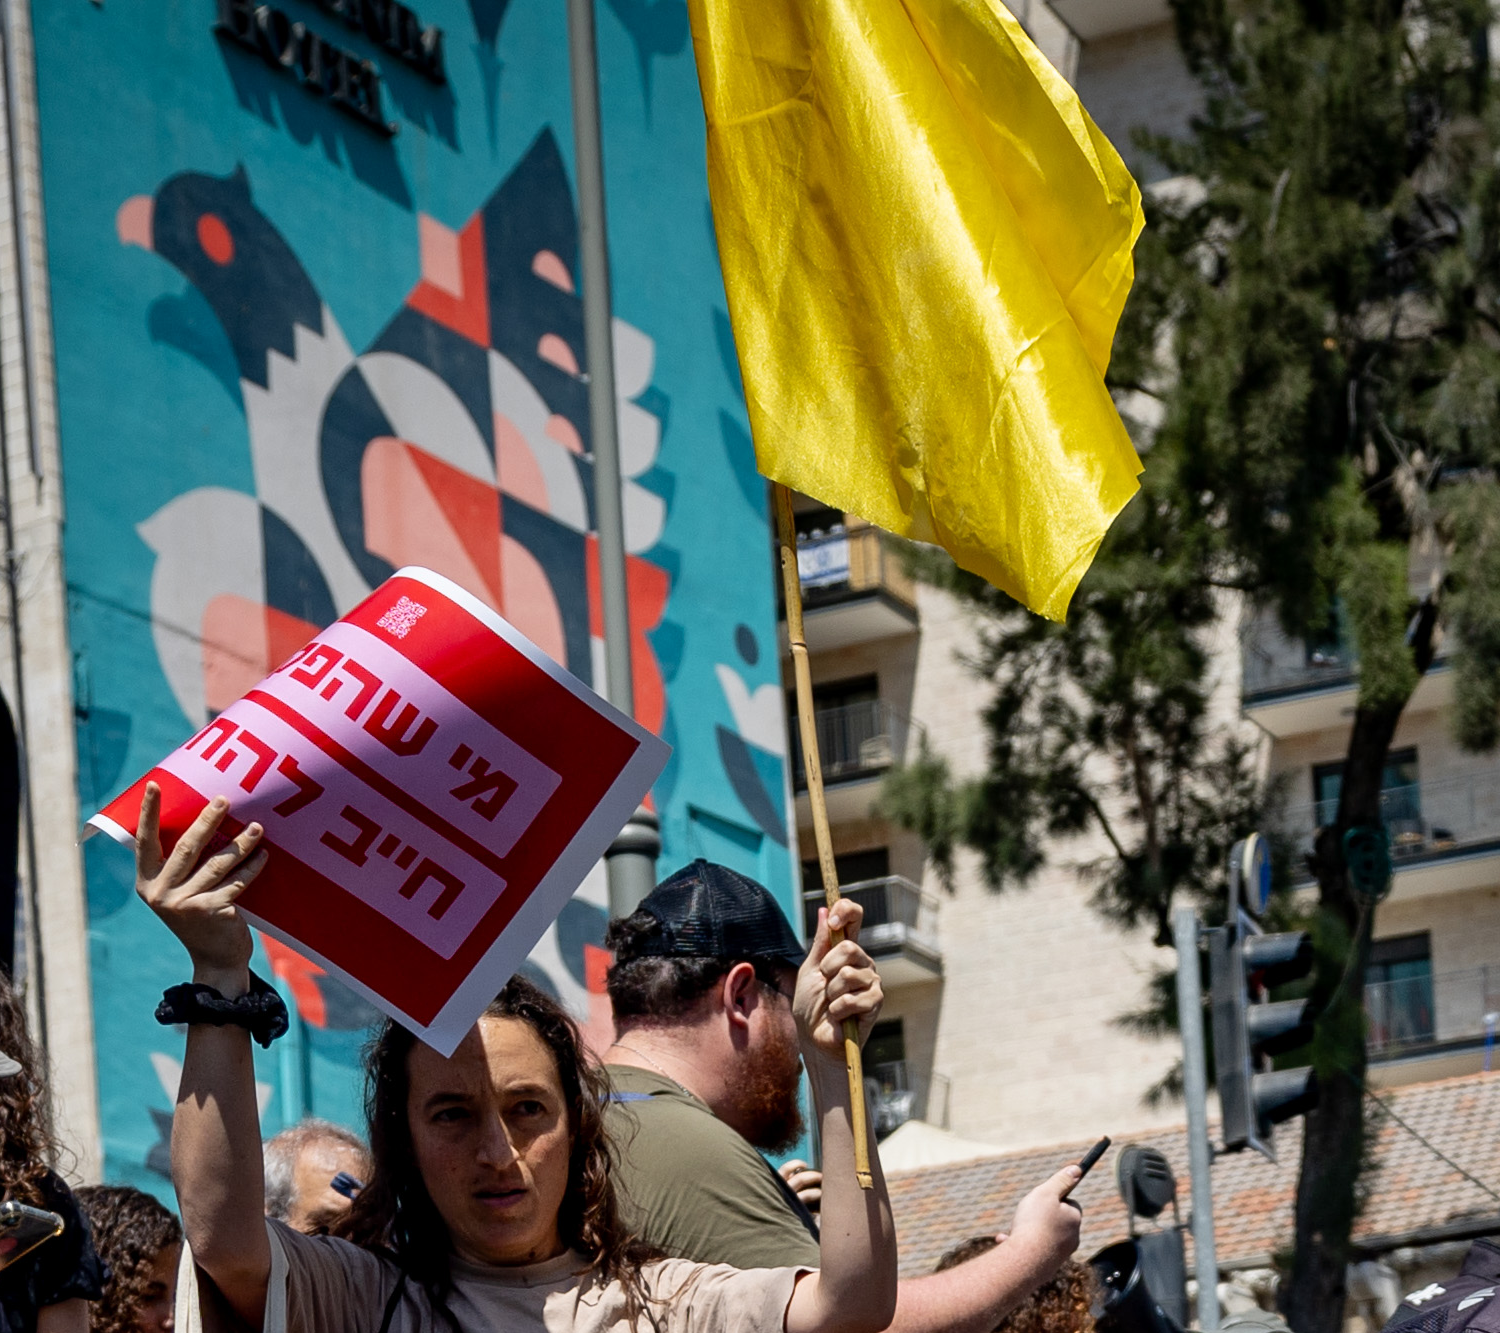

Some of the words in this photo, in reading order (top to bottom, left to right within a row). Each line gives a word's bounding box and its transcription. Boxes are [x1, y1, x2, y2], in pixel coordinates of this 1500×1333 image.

[183, 717, 326, 819] להח
[448, 742, 520, 824] מי
[319, 806, 467, 922] חייב
